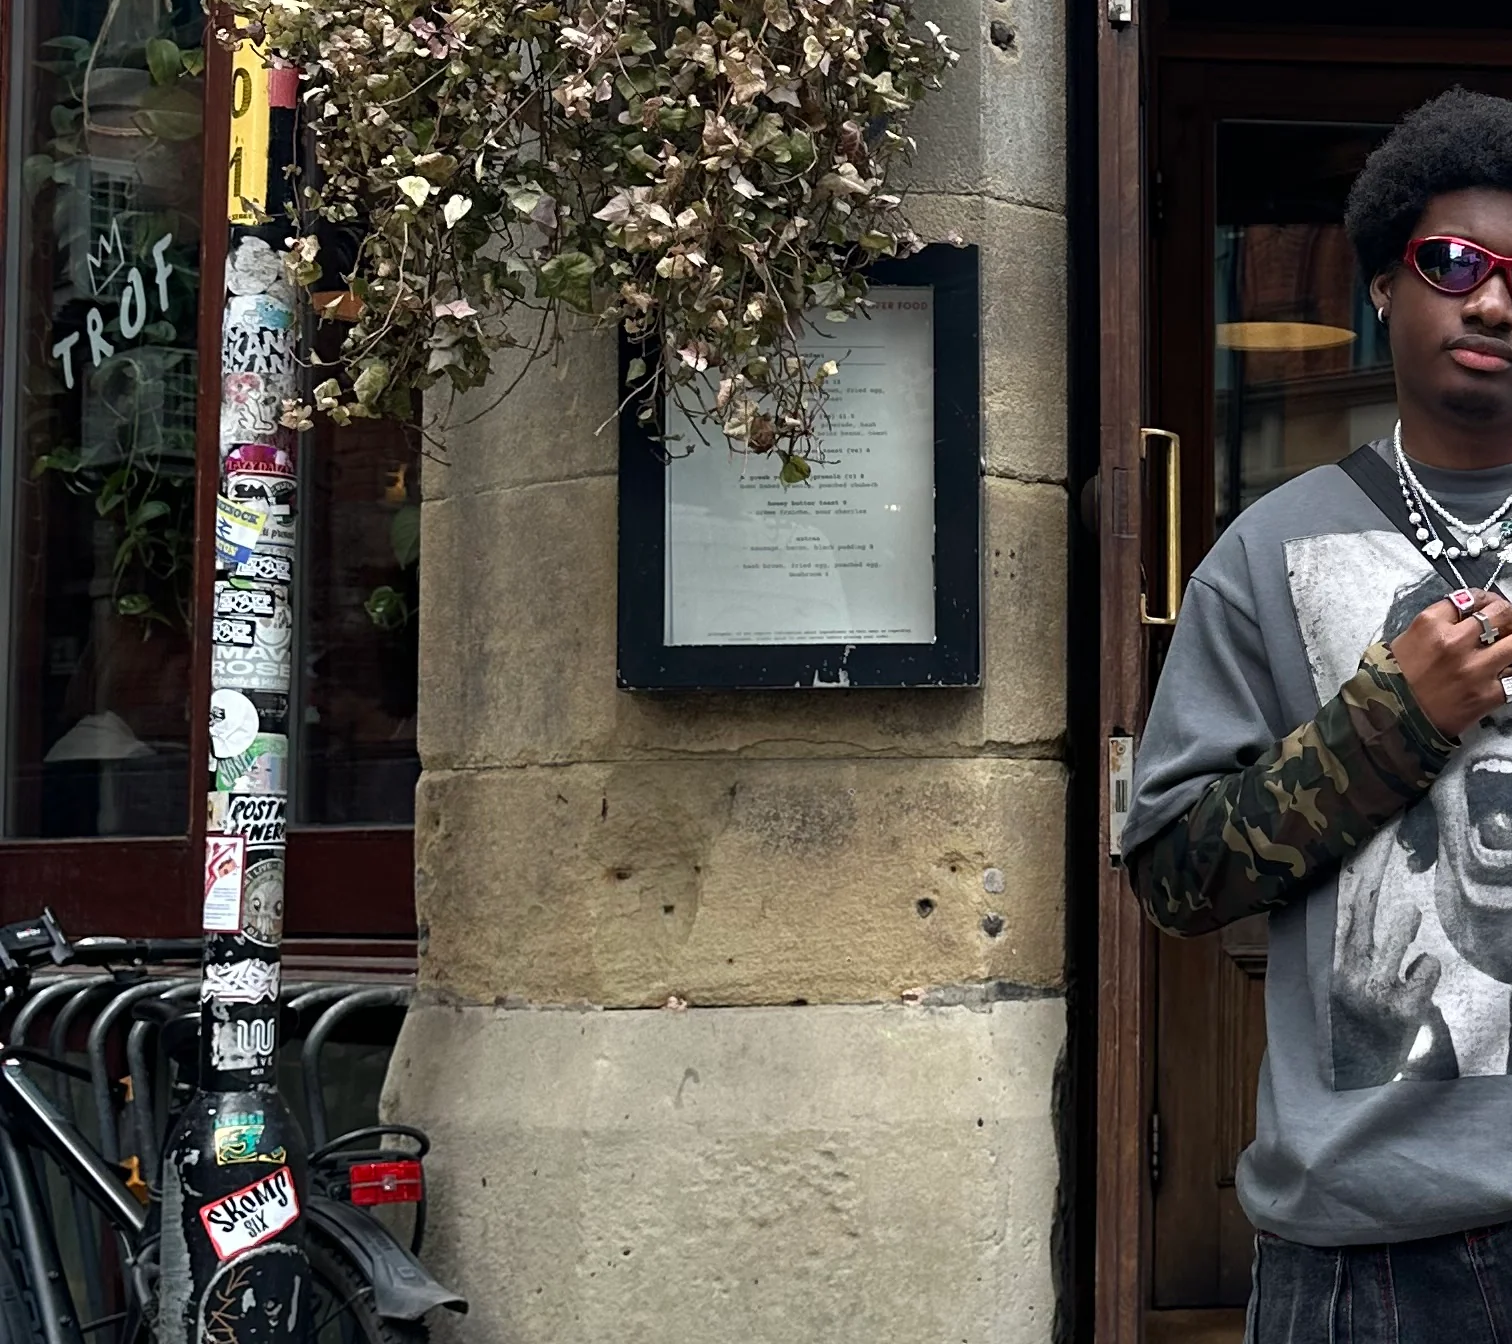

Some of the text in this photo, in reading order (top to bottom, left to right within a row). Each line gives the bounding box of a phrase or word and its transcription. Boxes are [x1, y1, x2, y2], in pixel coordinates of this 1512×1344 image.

[52, 232, 173, 390] TROF
[897, 301, 928, 311] FOOD
[212, 660, 291, 678] ROSE
[243, 1208, 270, 1239] SIX
